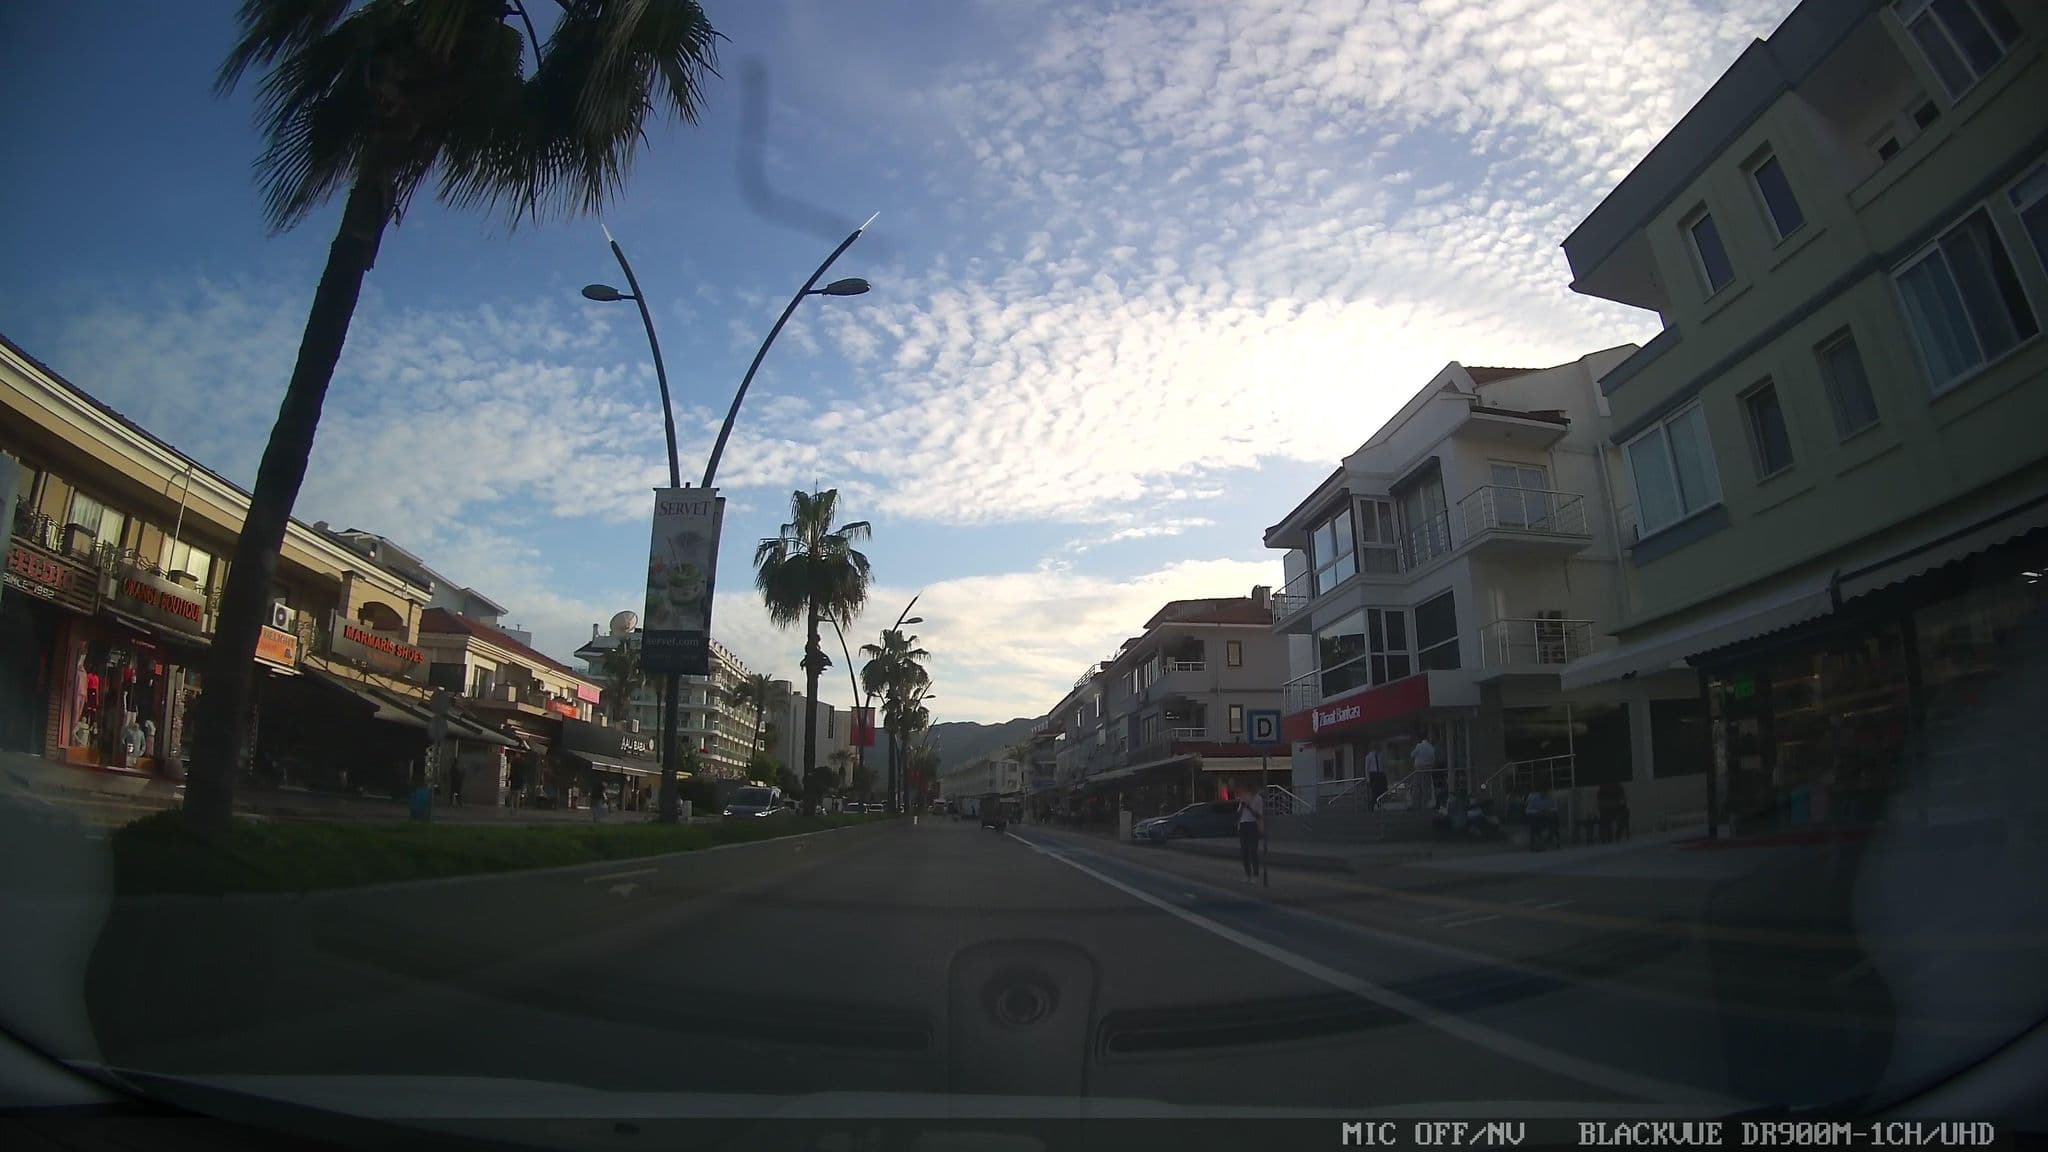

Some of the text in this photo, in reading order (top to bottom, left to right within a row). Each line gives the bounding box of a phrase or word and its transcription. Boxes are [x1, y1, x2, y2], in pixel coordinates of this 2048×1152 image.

[658, 500, 711, 516] SERVET
[3, 572, 55, 600] SINCE 1992
[647, 637, 699, 648] servet.com
[396, 645, 426, 664] SHOES
[1257, 718, 1272, 738] D
